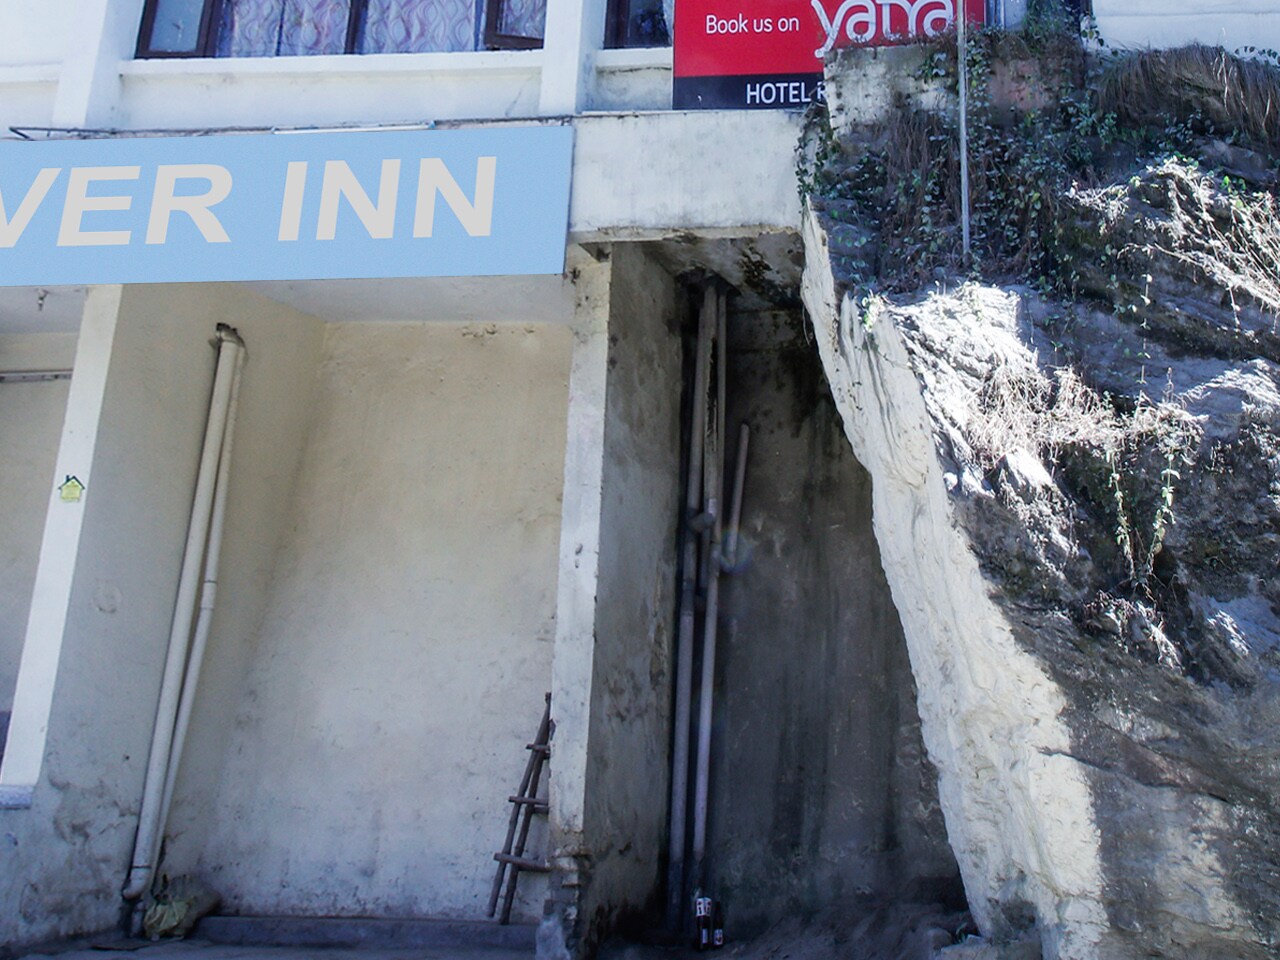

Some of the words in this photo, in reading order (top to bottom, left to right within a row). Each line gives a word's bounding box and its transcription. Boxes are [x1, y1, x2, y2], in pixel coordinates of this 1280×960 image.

[705, 13, 748, 35] Book
[752, 17, 773, 33] us
[777, 16, 800, 33] on
[746, 81, 812, 104] HOTEL
[278, 156, 498, 241] INN
